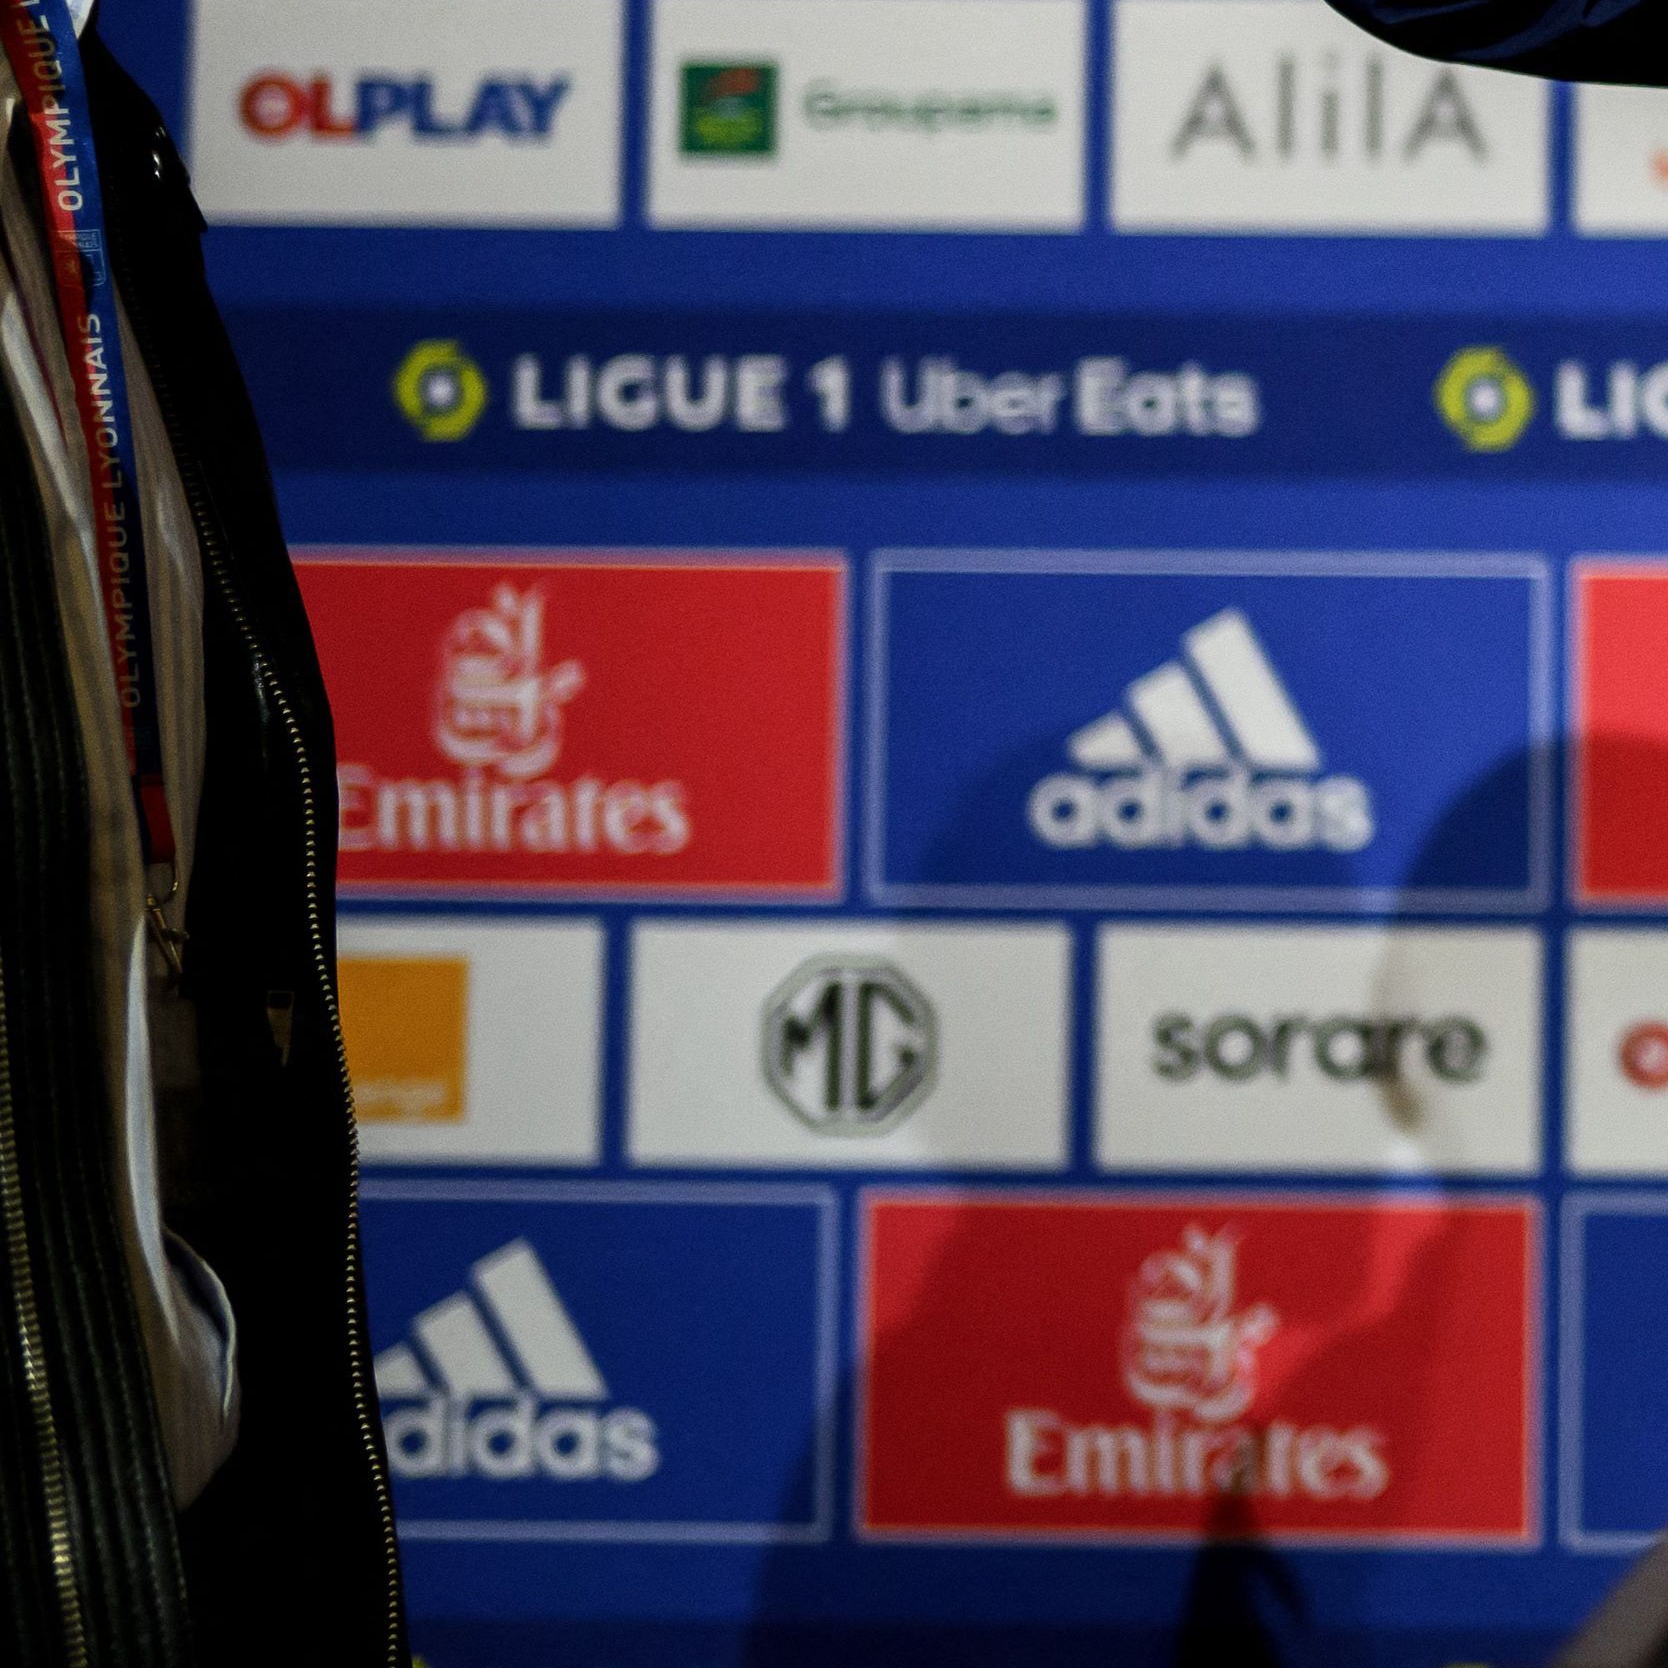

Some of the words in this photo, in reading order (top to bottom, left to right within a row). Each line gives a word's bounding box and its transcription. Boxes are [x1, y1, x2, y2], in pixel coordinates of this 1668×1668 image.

[236, 68, 572, 145] OLPLAY
[77, 312, 128, 490] LYONNAIS
[513, 355, 787, 433] LIGUE
[811, 356, 851, 431] 1
[882, 358, 1068, 436] Uber
[1074, 356, 1262, 438] Eats
[104, 499, 142, 710] OLYMPIQUE
[337, 763, 692, 855] Emirates
[1028, 764, 1378, 852] adidas
[769, 964, 932, 1129] MG
[1151, 1011, 1489, 1084] sorare
[383, 1394, 661, 1484] didas
[1006, 1407, 1390, 1500] Emirates
